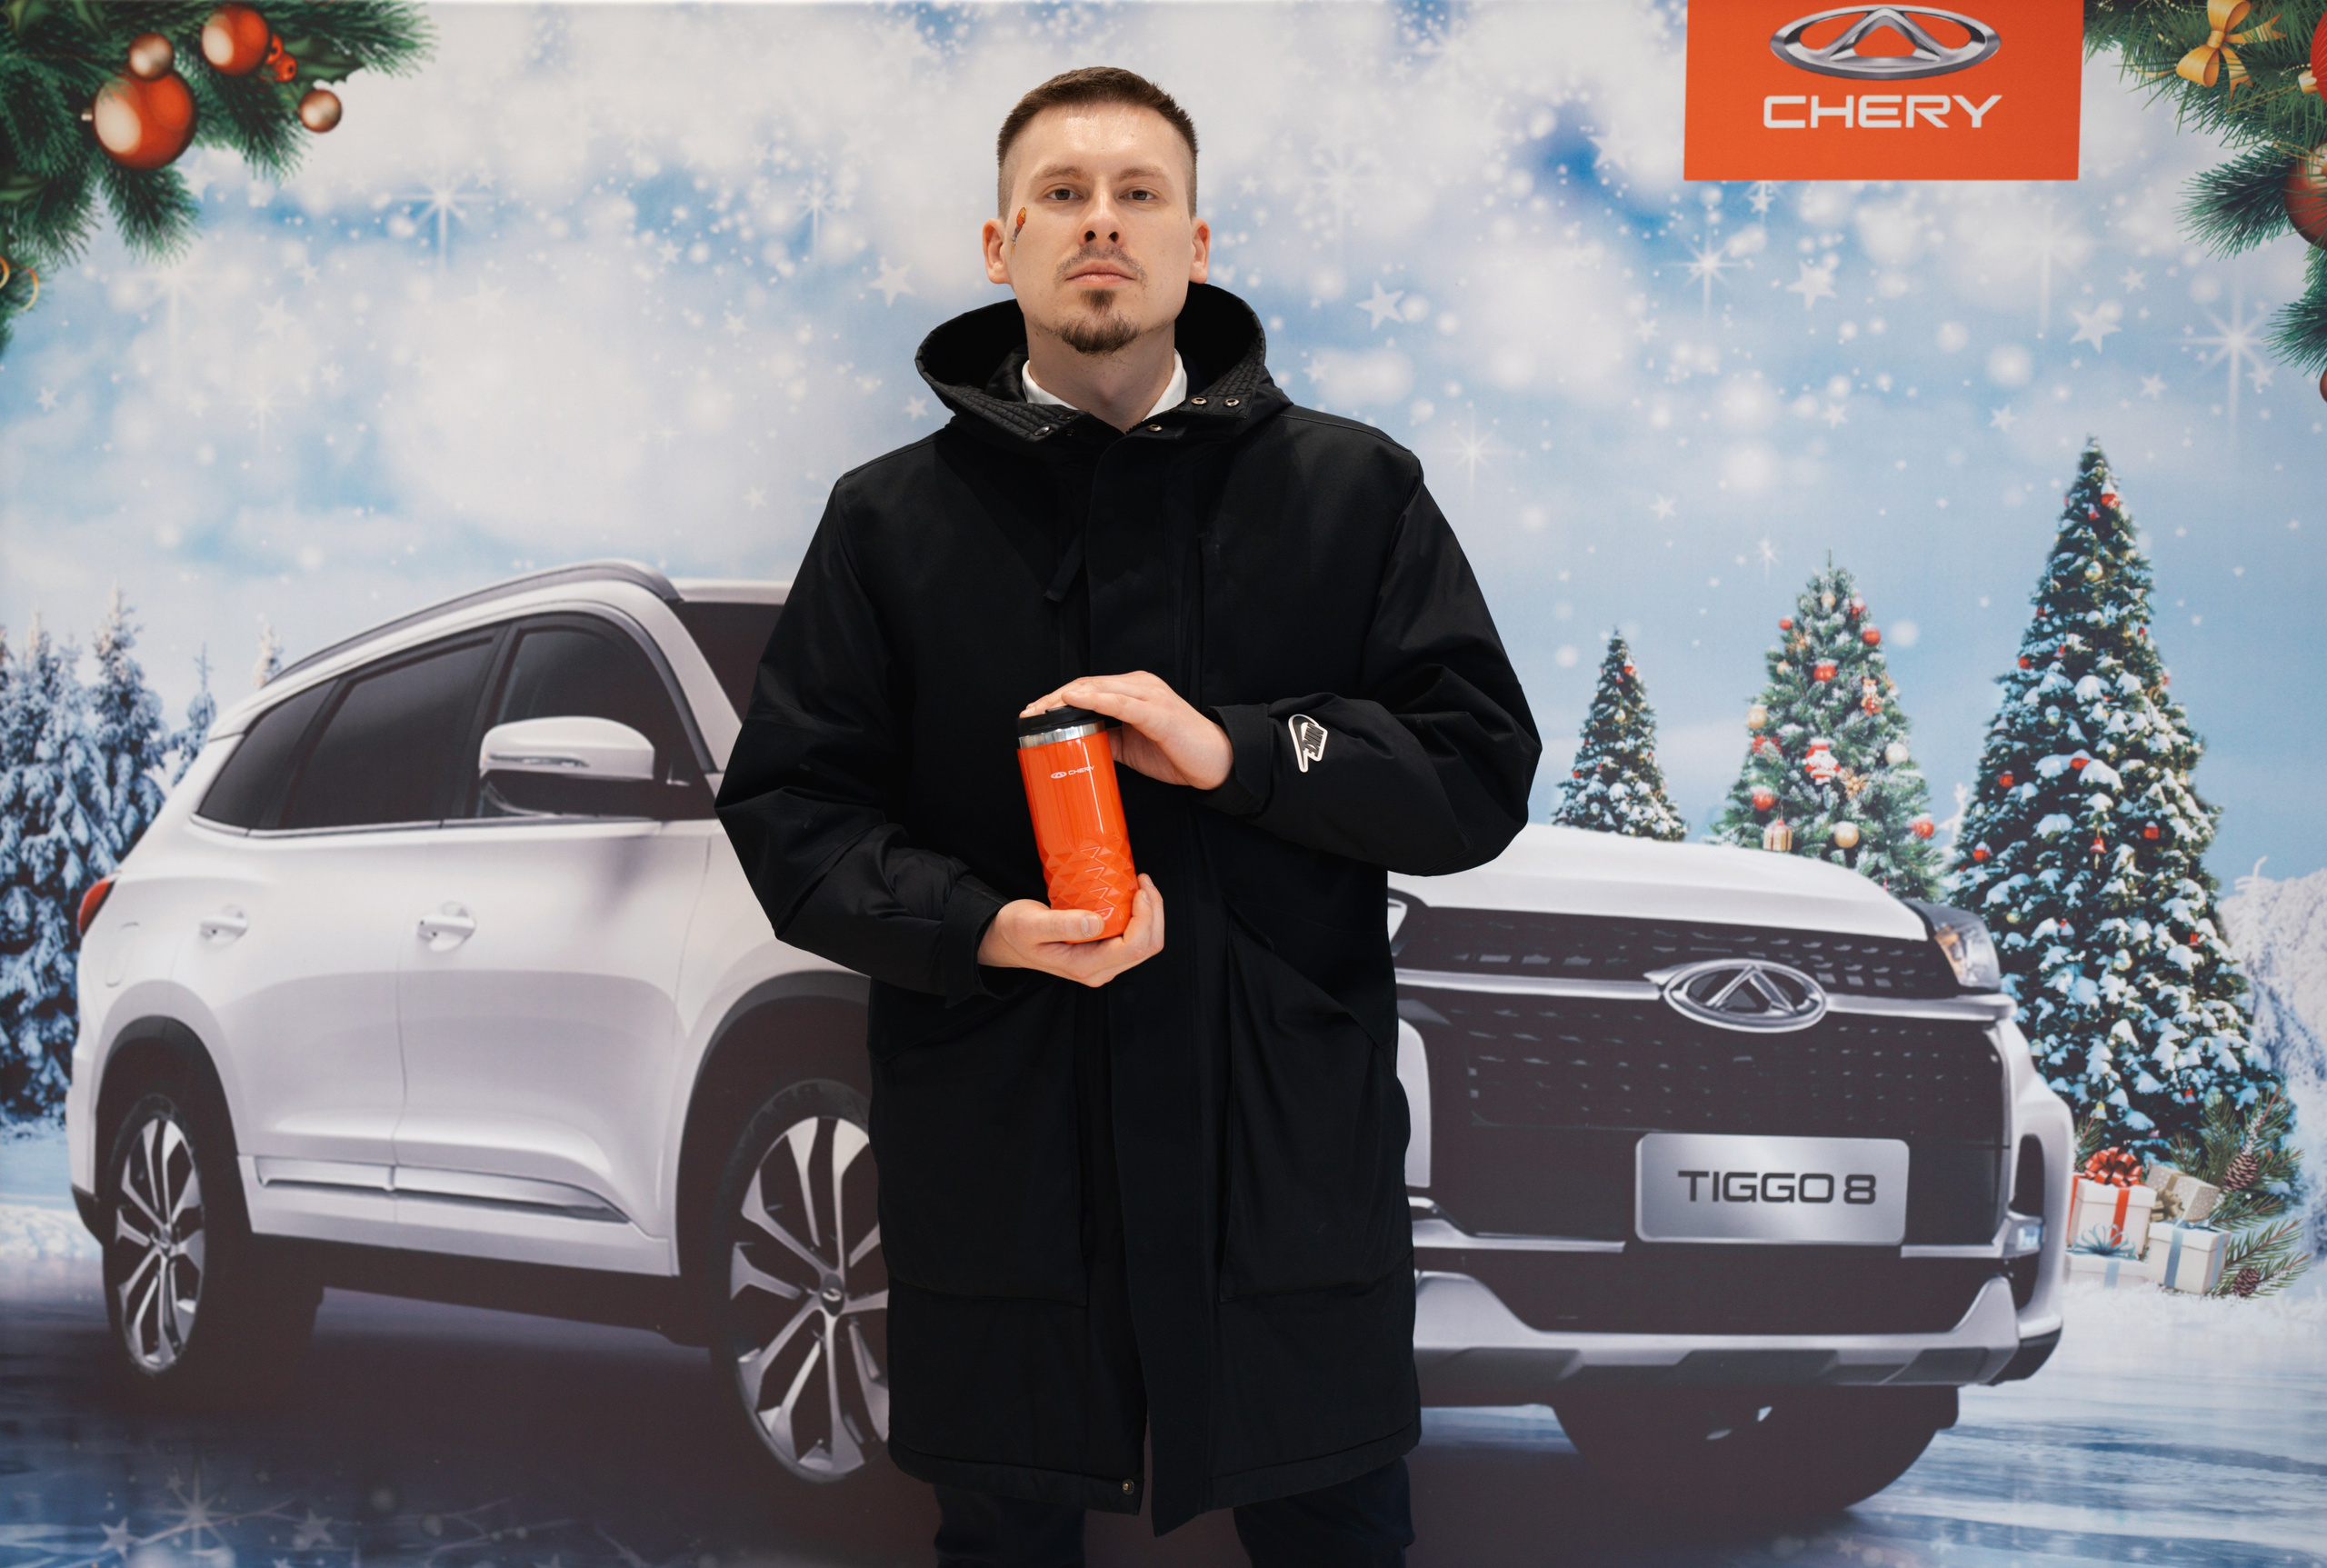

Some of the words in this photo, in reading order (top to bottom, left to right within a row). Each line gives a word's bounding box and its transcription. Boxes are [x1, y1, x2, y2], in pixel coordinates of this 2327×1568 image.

[1763, 95, 2003, 129] CHERY
[1303, 722, 1325, 758] NIKE
[1067, 764, 1095, 775] CHERY
[1678, 1170, 1834, 1204] TIGGO
[1843, 1174, 1877, 1205] 8
